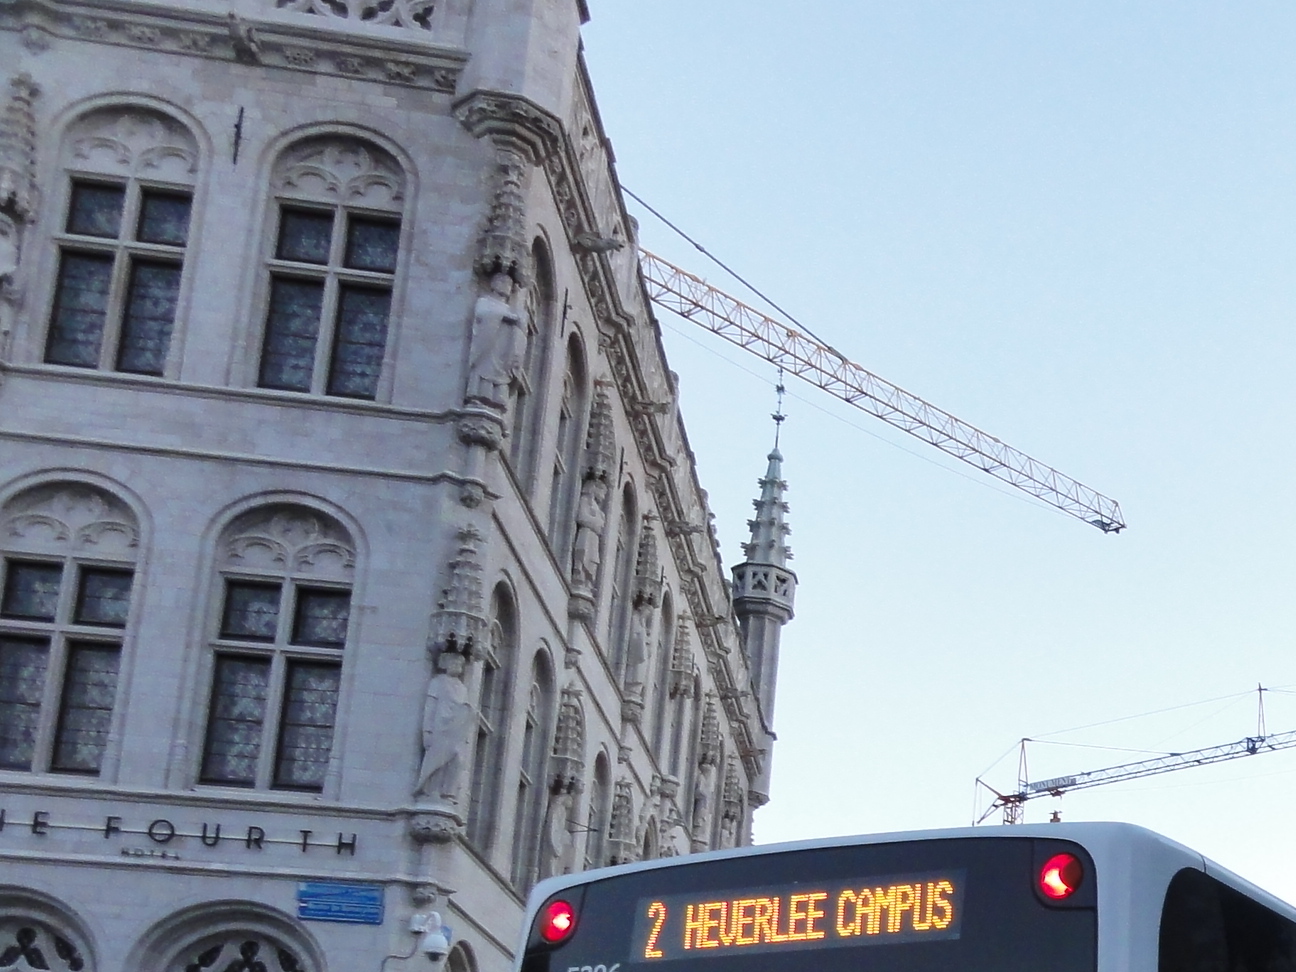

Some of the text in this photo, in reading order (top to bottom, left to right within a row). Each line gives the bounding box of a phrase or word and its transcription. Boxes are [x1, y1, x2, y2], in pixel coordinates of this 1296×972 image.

[105, 816, 357, 857] FOURTH
[644, 881, 954, 959] 2 HEVERLEE CAMPUS
